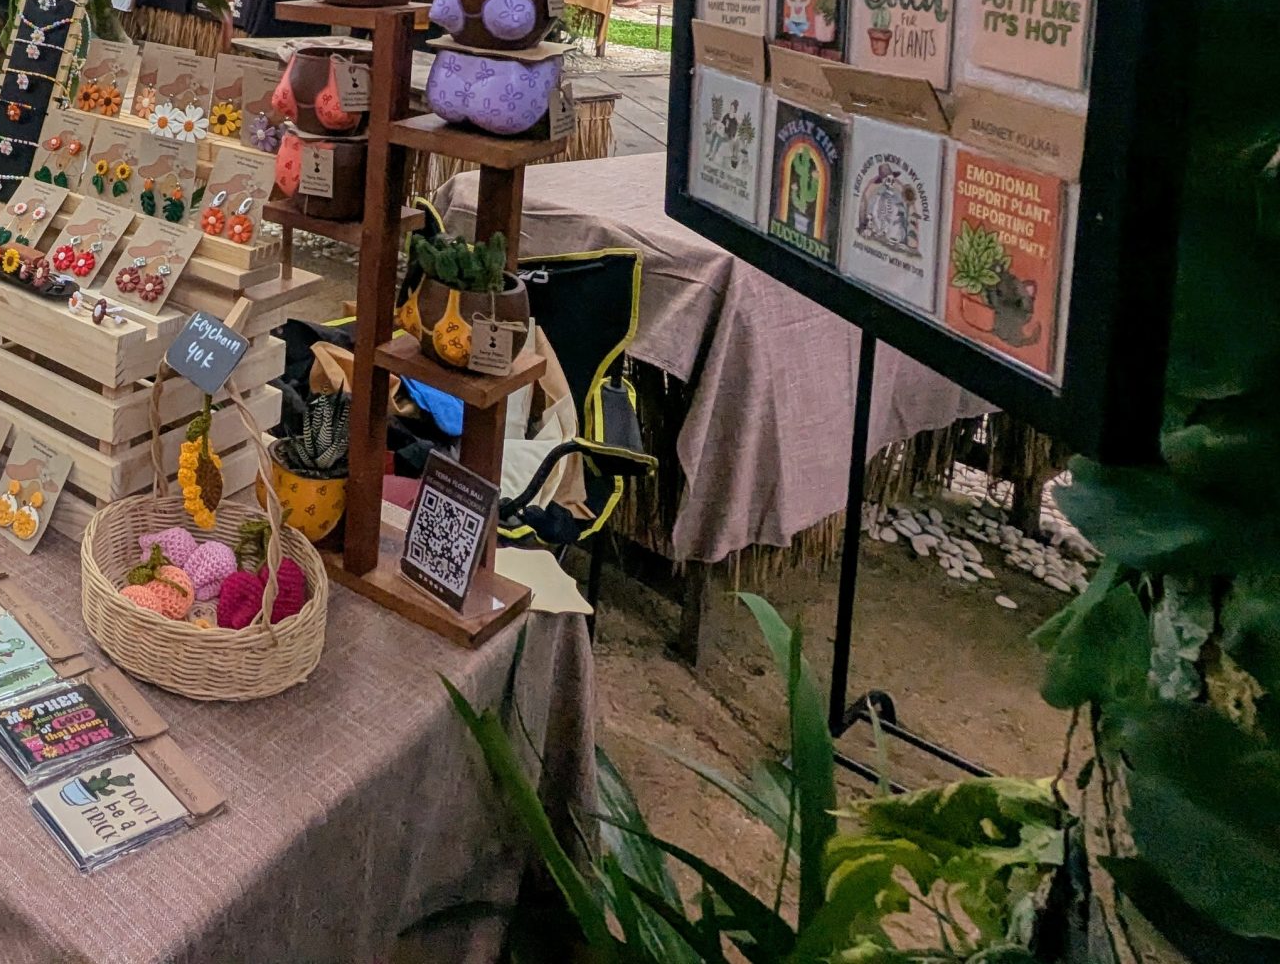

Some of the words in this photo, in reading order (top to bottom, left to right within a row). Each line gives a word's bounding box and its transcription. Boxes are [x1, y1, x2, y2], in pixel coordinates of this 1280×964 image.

[722, 15, 746, 26] PLANTS
[984, 10, 1018, 36] IT'S
[1025, 18, 1072, 46] HOT
[893, 26, 936, 60] PLANTS
[778, 119, 815, 142] WHAT
[815, 127, 838, 164] THE
[957, 180, 1007, 209] SUPPORT
[966, 164, 1041, 202] EMOTIONAL
[916, 183, 931, 222] GARDEN
[968, 202, 1035, 237] REPORTING
[771, 220, 830, 263] SUCCULENT
[998, 230, 1017, 245] FOR
[59, 710, 92, 726] LOVE
[68, 718, 103, 734] bloom
[104, 800, 125, 818] be
[121, 820, 136, 831] a
[121, 790, 162, 824] DON'T
[81, 806, 121, 844] PRICK
